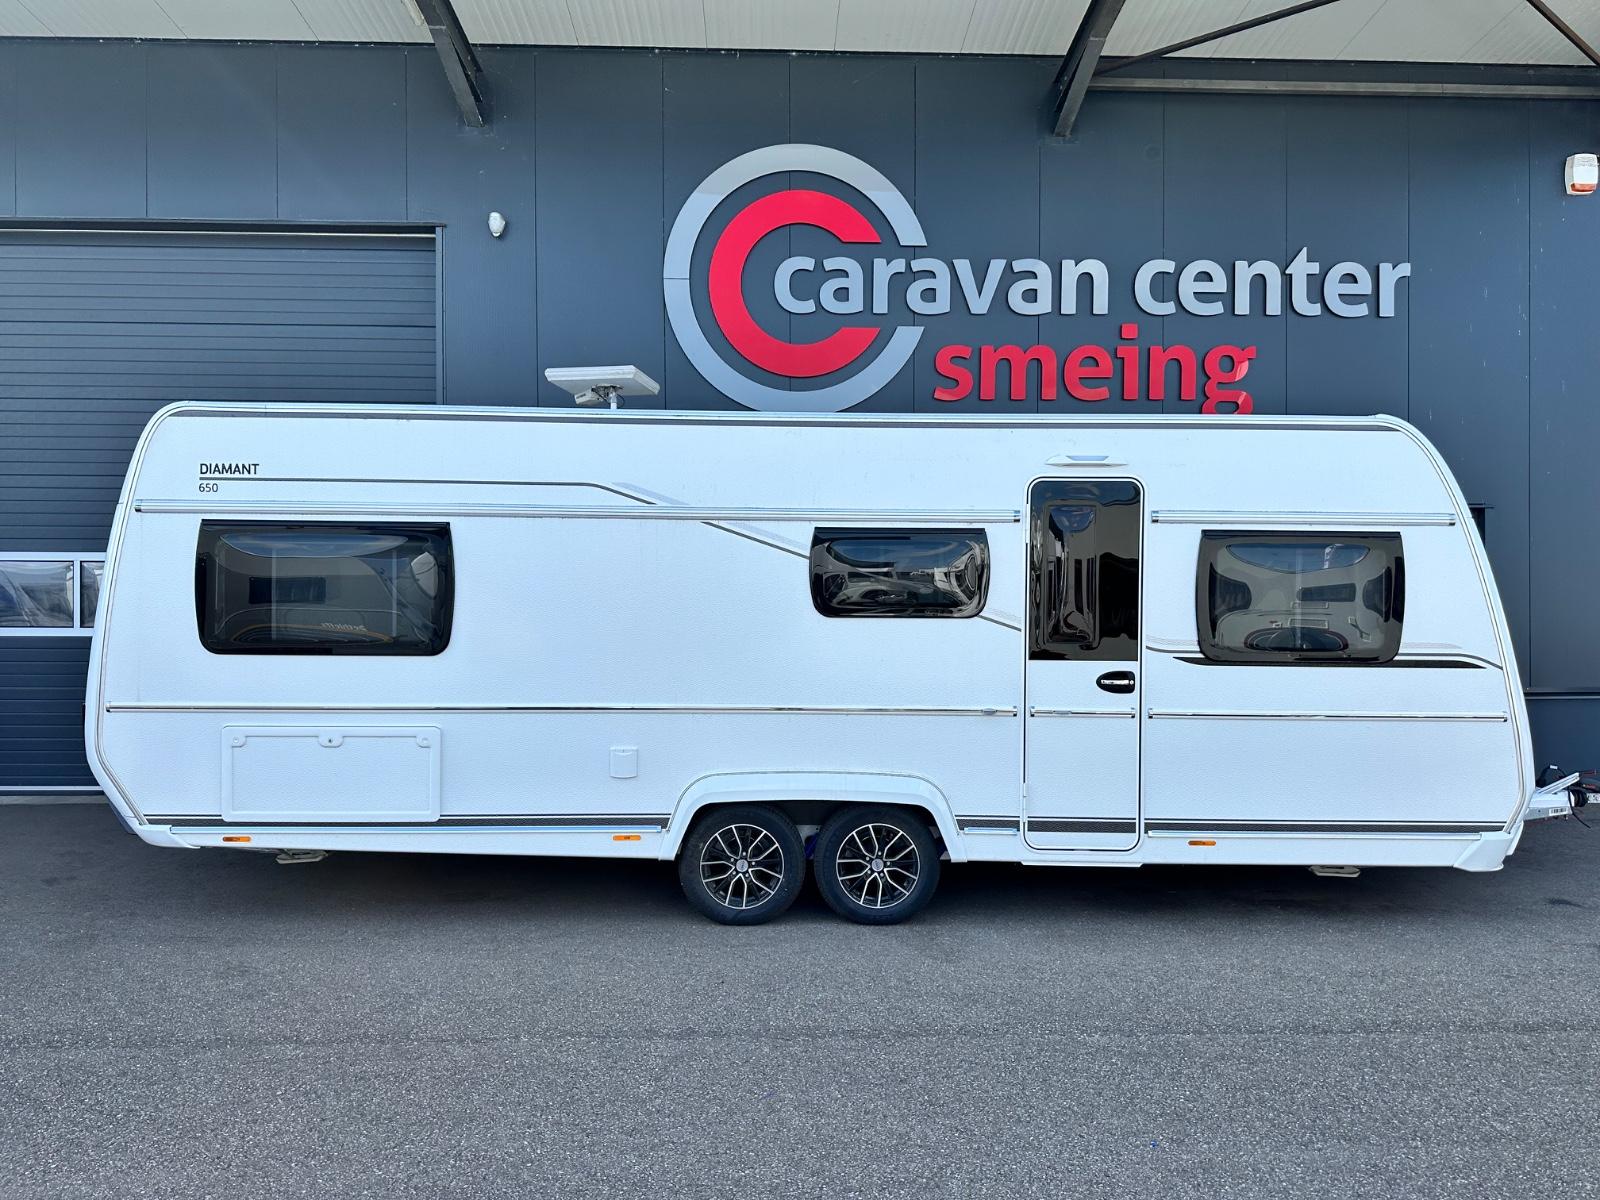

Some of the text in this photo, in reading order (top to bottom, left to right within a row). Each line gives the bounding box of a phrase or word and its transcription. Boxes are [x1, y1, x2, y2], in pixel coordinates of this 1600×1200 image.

[774, 246, 1411, 317] caravan center
[934, 323, 1256, 414] smeing
[198, 482, 219, 493] 650
[199, 463, 260, 475] DIAMANT
